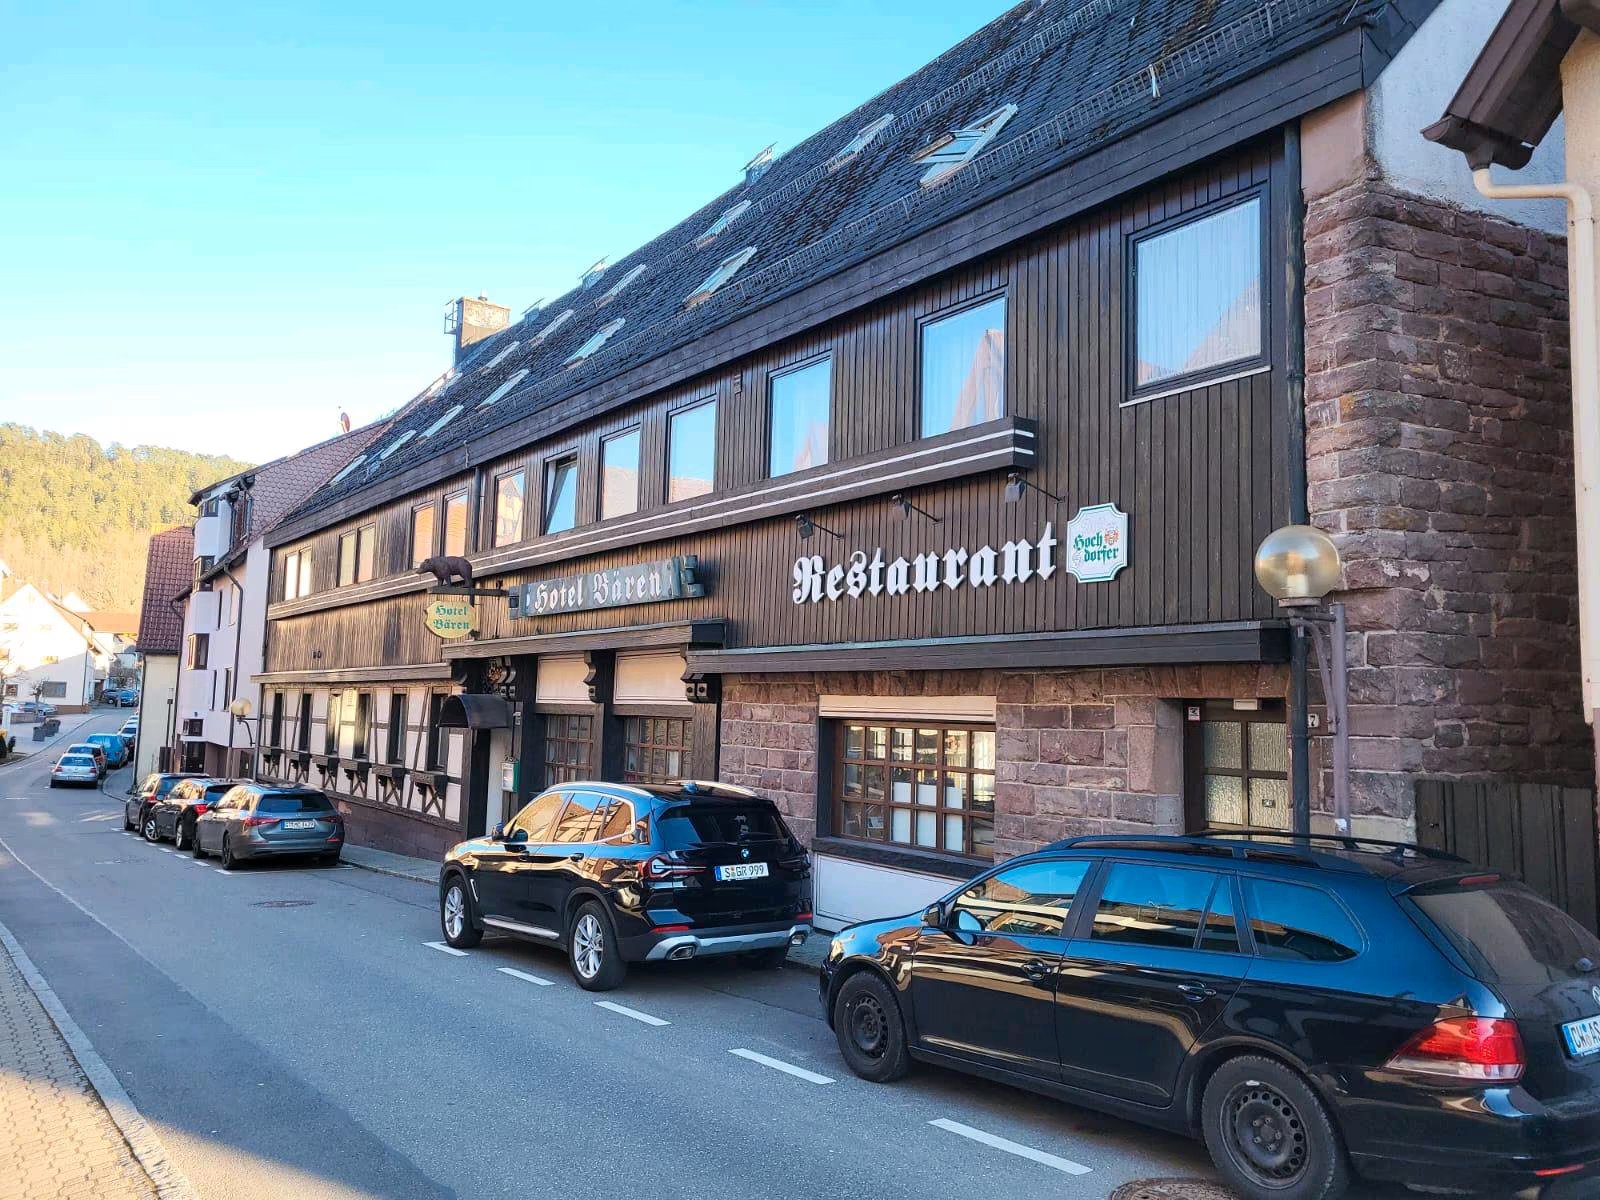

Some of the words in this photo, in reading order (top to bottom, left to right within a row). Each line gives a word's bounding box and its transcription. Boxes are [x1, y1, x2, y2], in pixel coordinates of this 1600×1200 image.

[1073, 531, 1103, 551] Hoch
[792, 521, 1057, 604] Restaurant
[1084, 545, 1119, 565] dorfer
[534, 578, 584, 613] Hotel
[593, 571, 662, 604] Bären
[435, 605, 467, 618] Hotel
[433, 619, 469, 630] Bären
